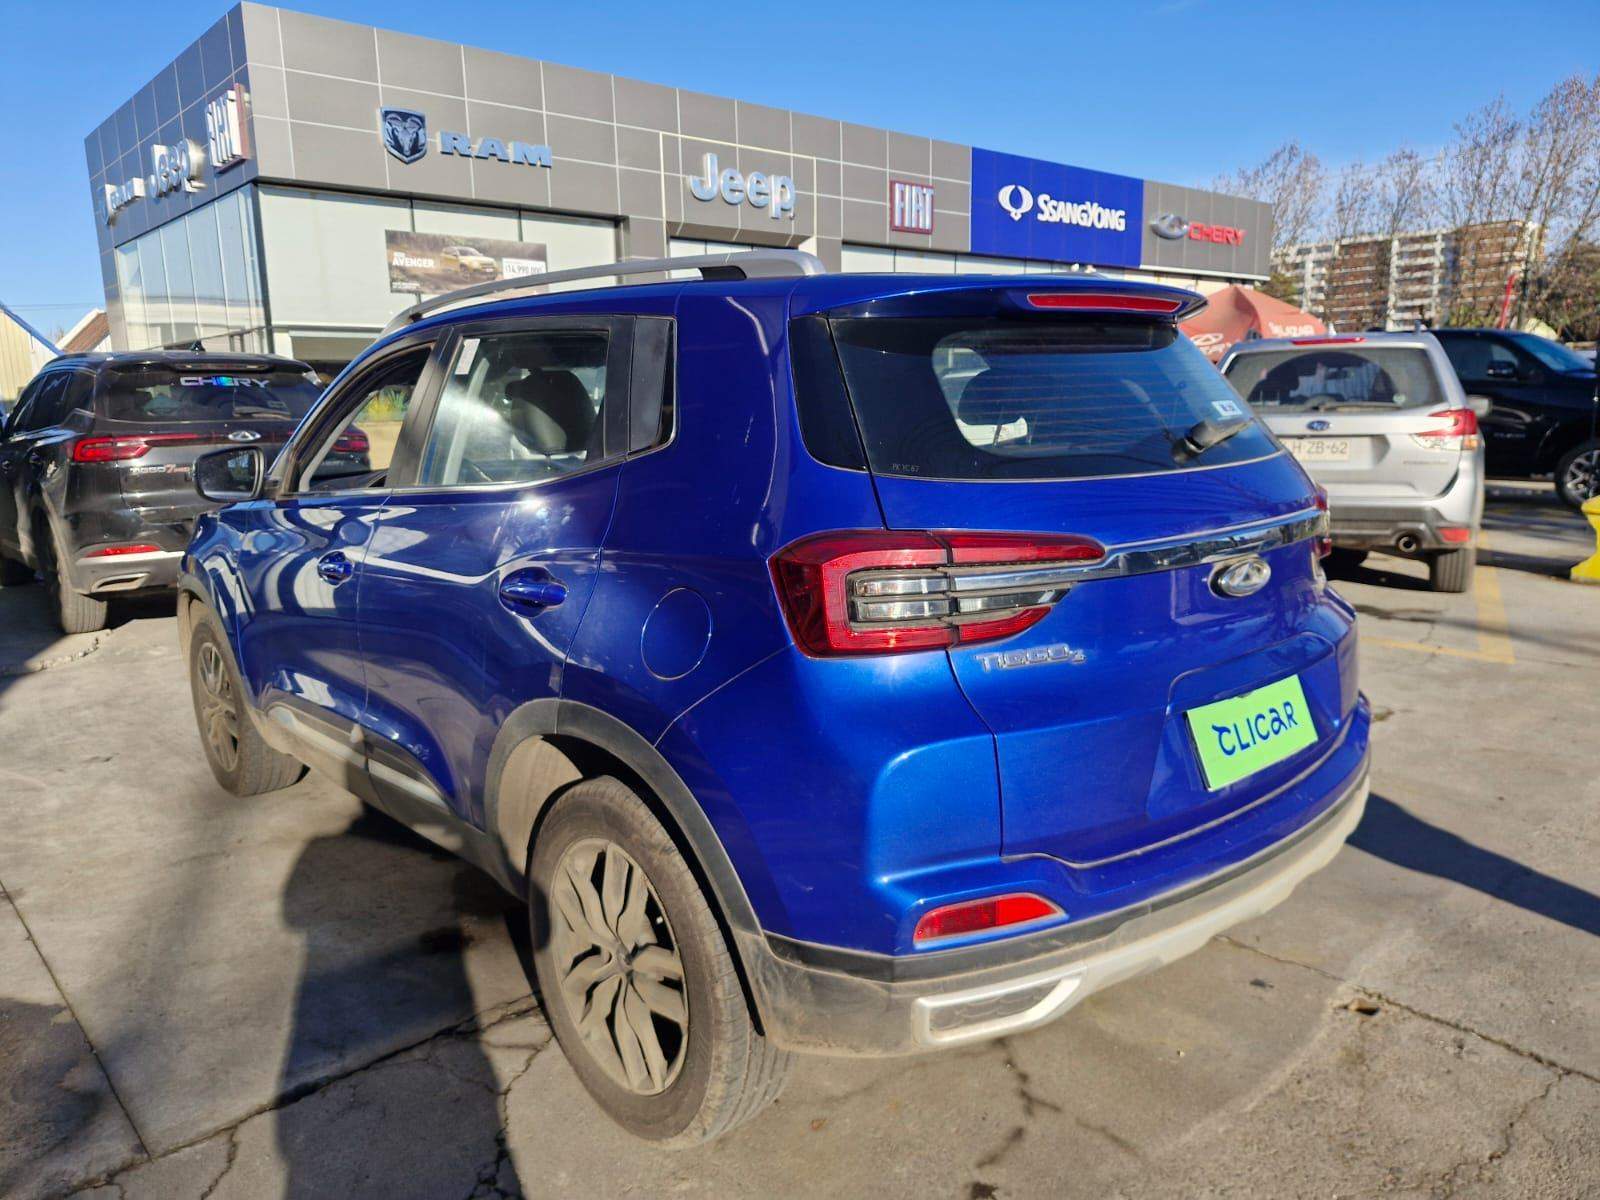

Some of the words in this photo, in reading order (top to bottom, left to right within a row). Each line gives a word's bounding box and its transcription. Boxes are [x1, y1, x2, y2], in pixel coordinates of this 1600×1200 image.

[436, 130, 552, 168] RAM
[688, 152, 797, 219] Jeep
[894, 182, 934, 230] FIAT
[1188, 221, 1247, 246] CHERY
[392, 255, 435, 268] AVENGER
[180, 376, 270, 388] CHERY
